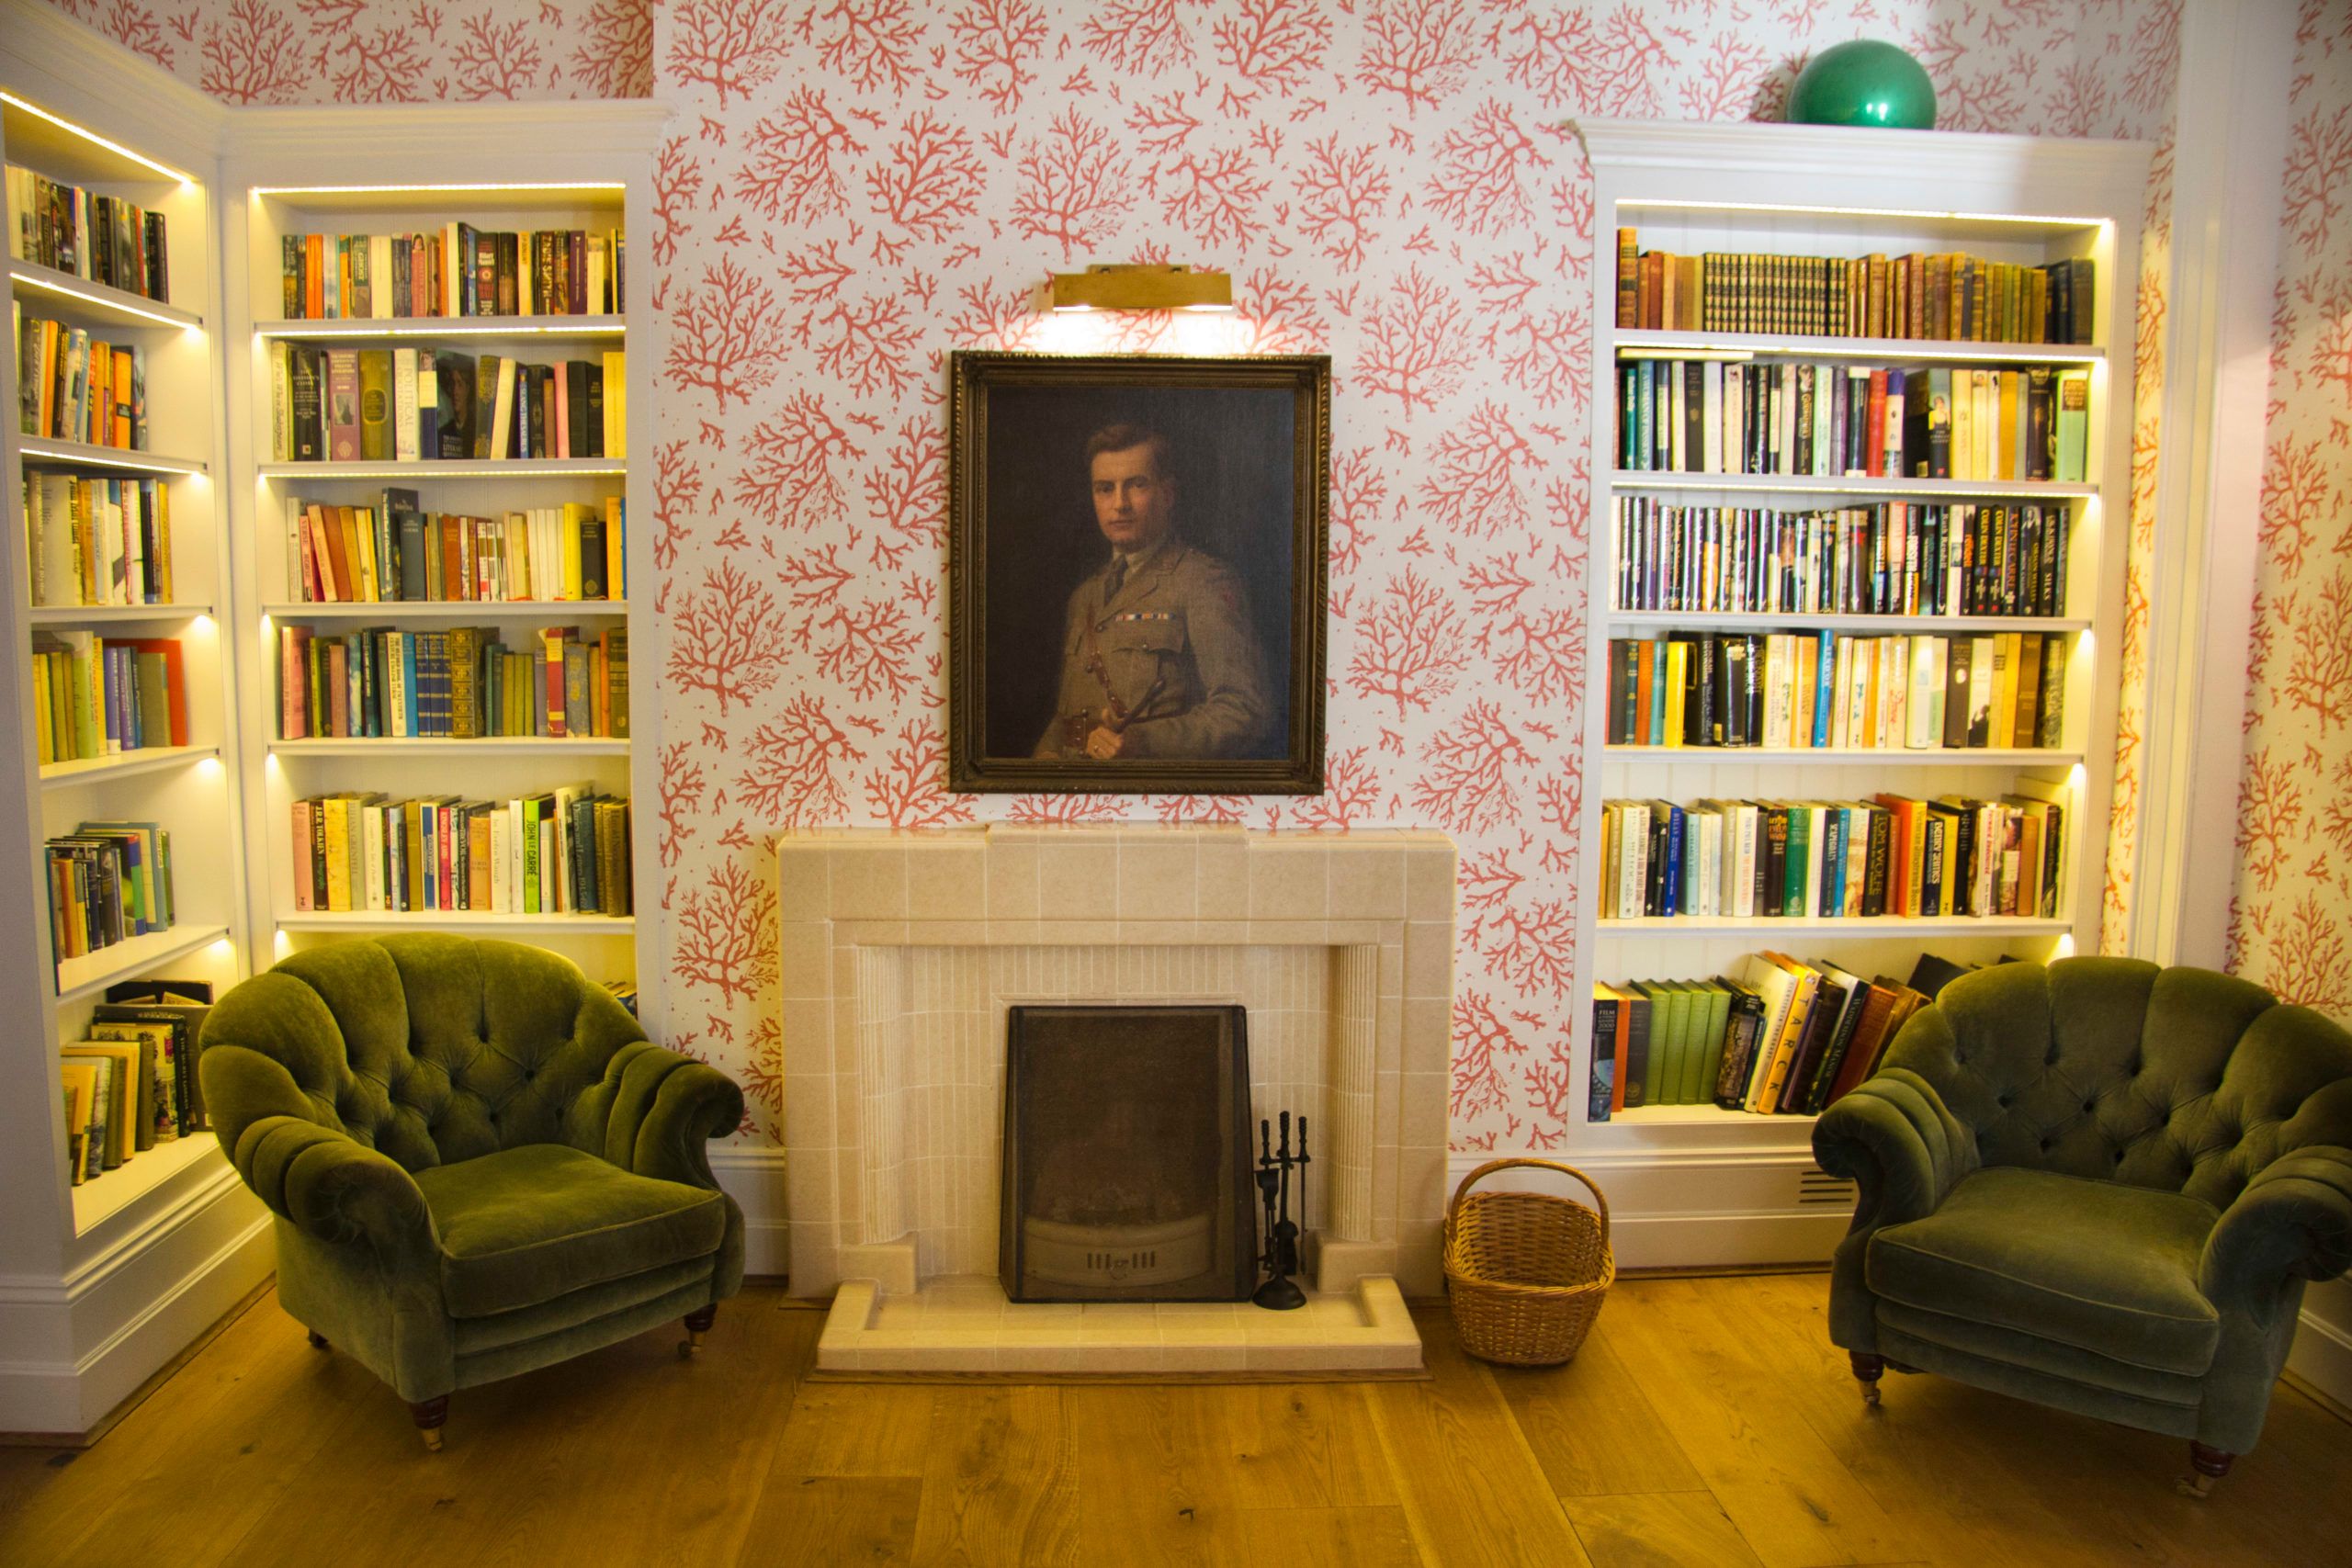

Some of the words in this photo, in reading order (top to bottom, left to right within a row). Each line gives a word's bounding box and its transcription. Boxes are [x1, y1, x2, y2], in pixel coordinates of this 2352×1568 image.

[404, 368, 413, 426] POLITICAL
[1980, 509, 1990, 534] COLIN
[1994, 510, 2003, 535] COLIN
[1979, 535, 1989, 565] DEXTER
[1993, 536, 2002, 566] DEXTER
[2044, 572, 2052, 600] SILKS
[526, 819, 535, 840] JOHN
[573, 804, 581, 831] Diaries
[1878, 817, 1887, 844] TOM
[350, 835, 358, 874] GRENFELL
[1828, 824, 1838, 862] SCAPEGOATS
[526, 850, 537, 876] CARRÉ
[576, 847, 584, 873] Letters
[1874, 848, 1885, 895] WOLFE
[1912, 846, 1922, 887] Illustrated
[1911, 889, 1920, 912] Books
[1769, 974, 1816, 1092] STARCK
